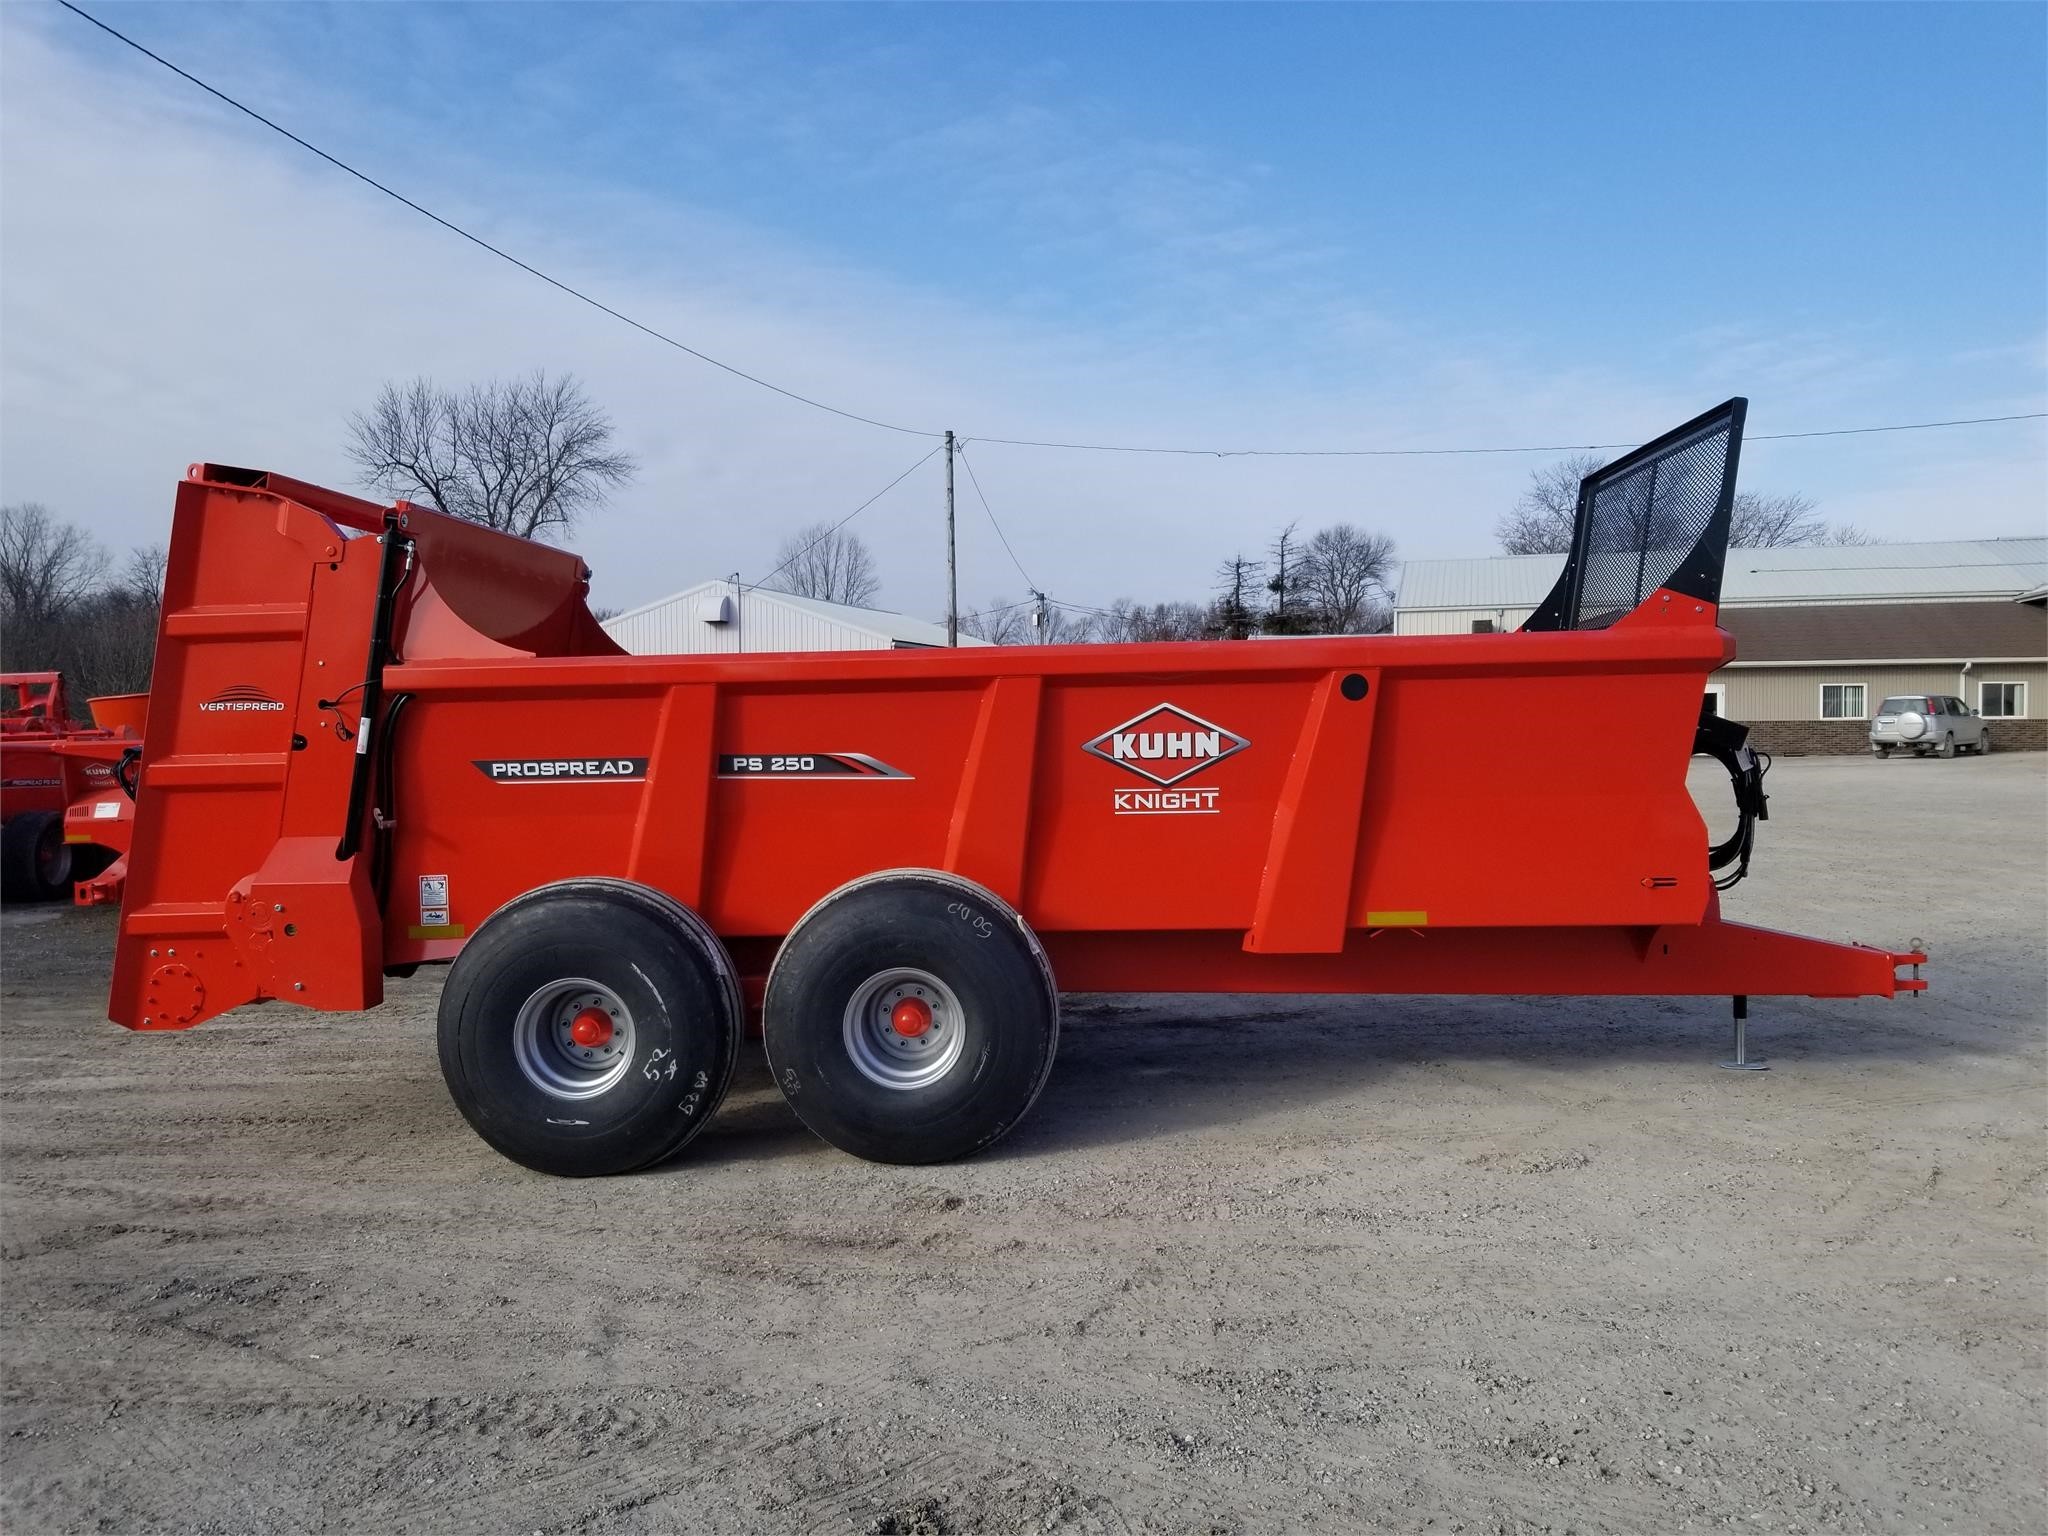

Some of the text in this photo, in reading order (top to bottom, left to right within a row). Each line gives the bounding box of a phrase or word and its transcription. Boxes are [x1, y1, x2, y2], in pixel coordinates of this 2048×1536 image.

[199, 702, 285, 712] VERTISPREAD
[1112, 731, 1220, 760] KUHN
[492, 757, 815, 777] PROSPREAD PS 250
[1114, 792, 1220, 810] KNIGHT
